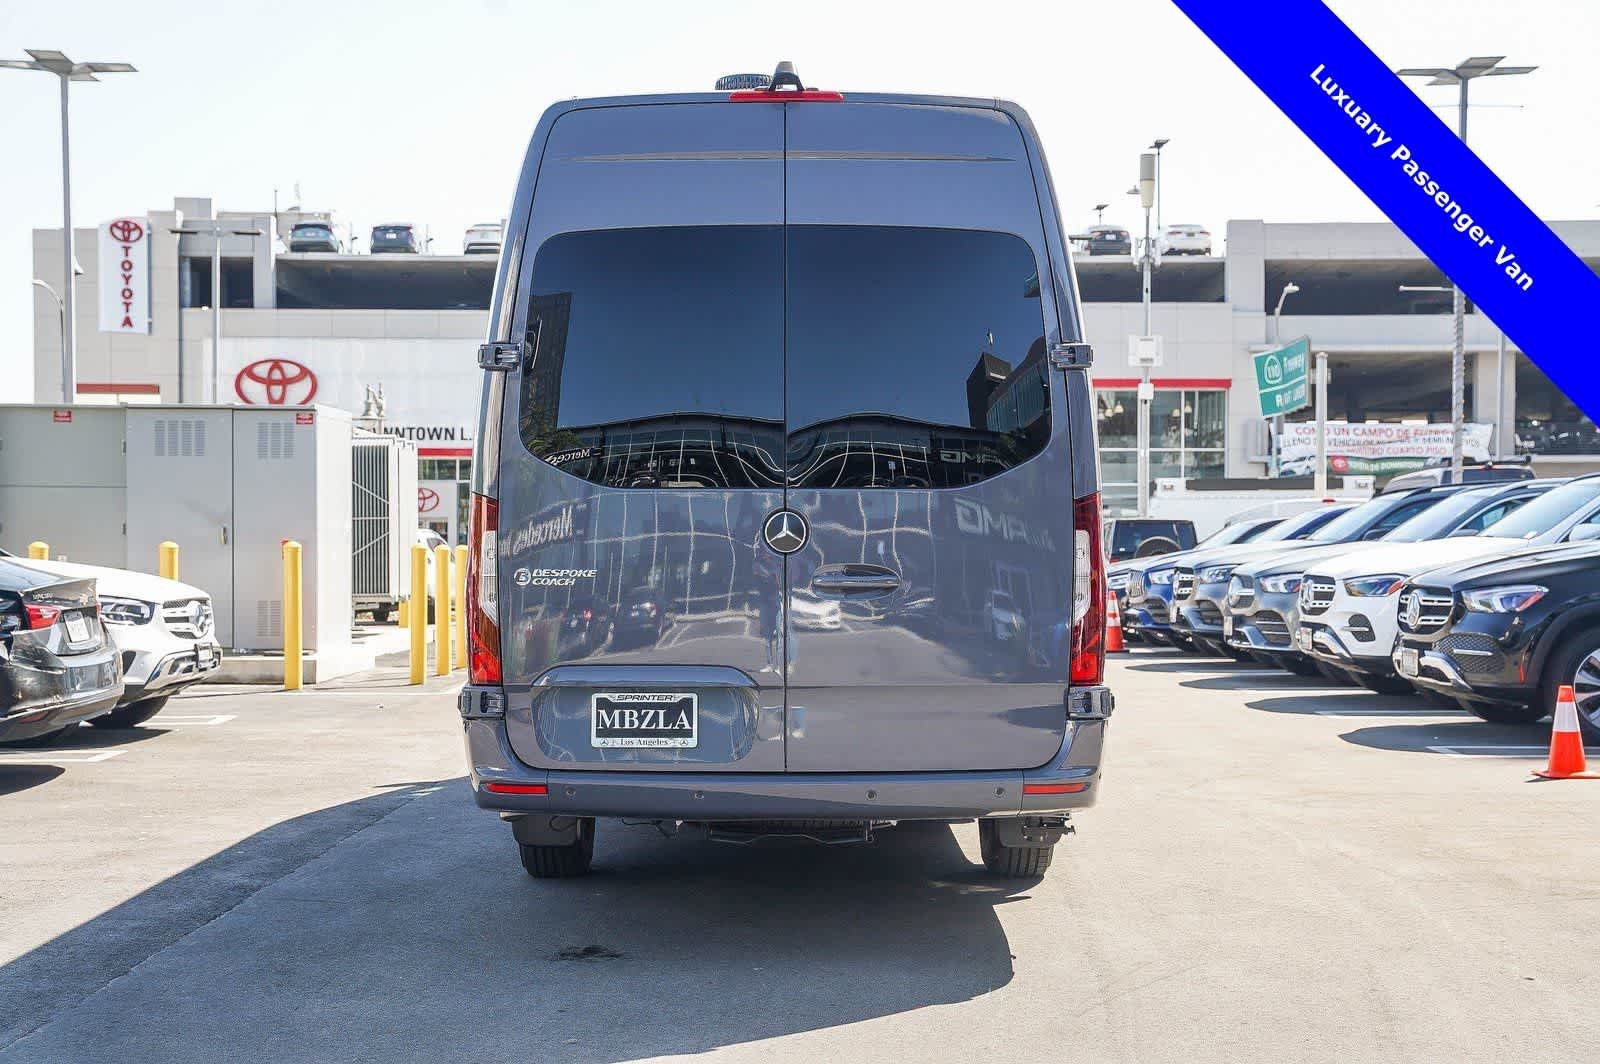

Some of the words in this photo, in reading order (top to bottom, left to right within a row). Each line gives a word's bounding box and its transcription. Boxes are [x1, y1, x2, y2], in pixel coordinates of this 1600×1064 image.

[121, 246, 133, 328] TOYOTA
[1353, 427, 1393, 438] CAMPO
[532, 568, 597, 577] BESPOKE
[532, 577, 576, 586] COACH
[597, 709, 693, 729] MBZLA
[620, 738, 634, 746] Los
[637, 738, 668, 747] Angeles
